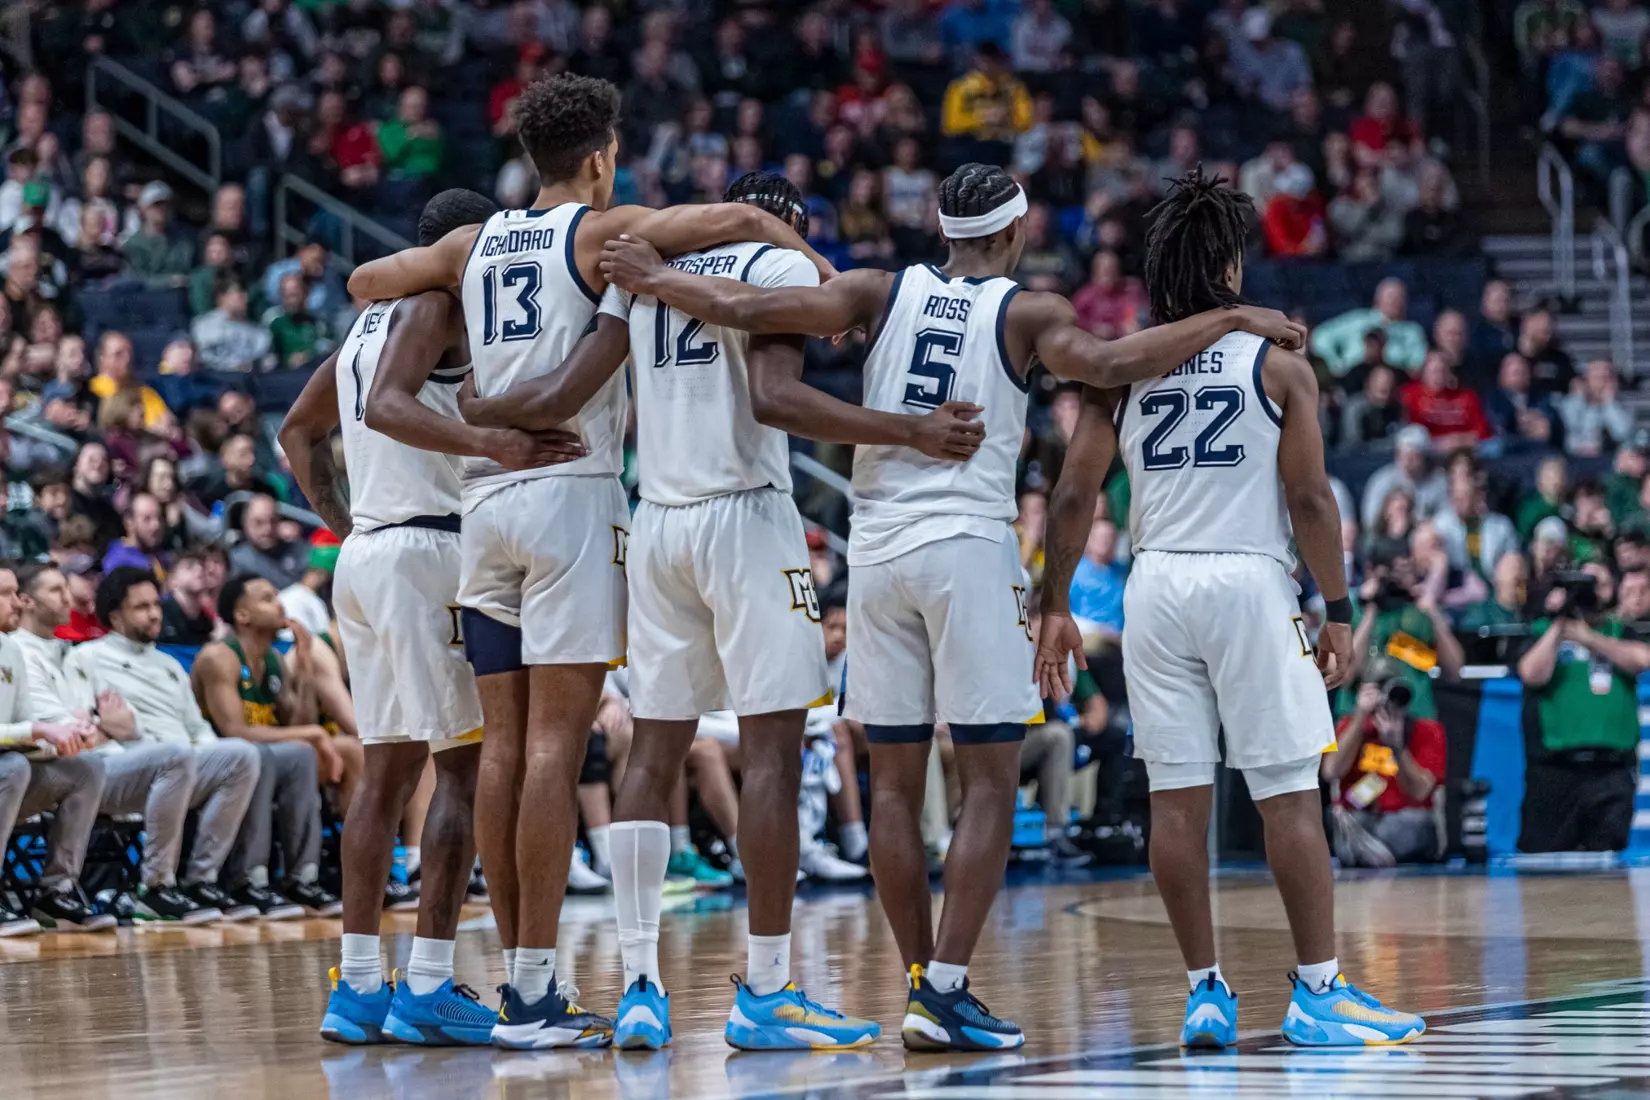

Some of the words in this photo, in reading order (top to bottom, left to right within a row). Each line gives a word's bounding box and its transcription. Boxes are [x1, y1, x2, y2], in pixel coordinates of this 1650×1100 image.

[482, 261, 543, 345] 13
[653, 296, 720, 368] 12
[923, 294, 972, 323] ROSS
[351, 342, 365, 421] 1
[901, 328, 964, 411] 5
[1161, 351, 1224, 379] NES
[1138, 384, 1247, 471] 22
